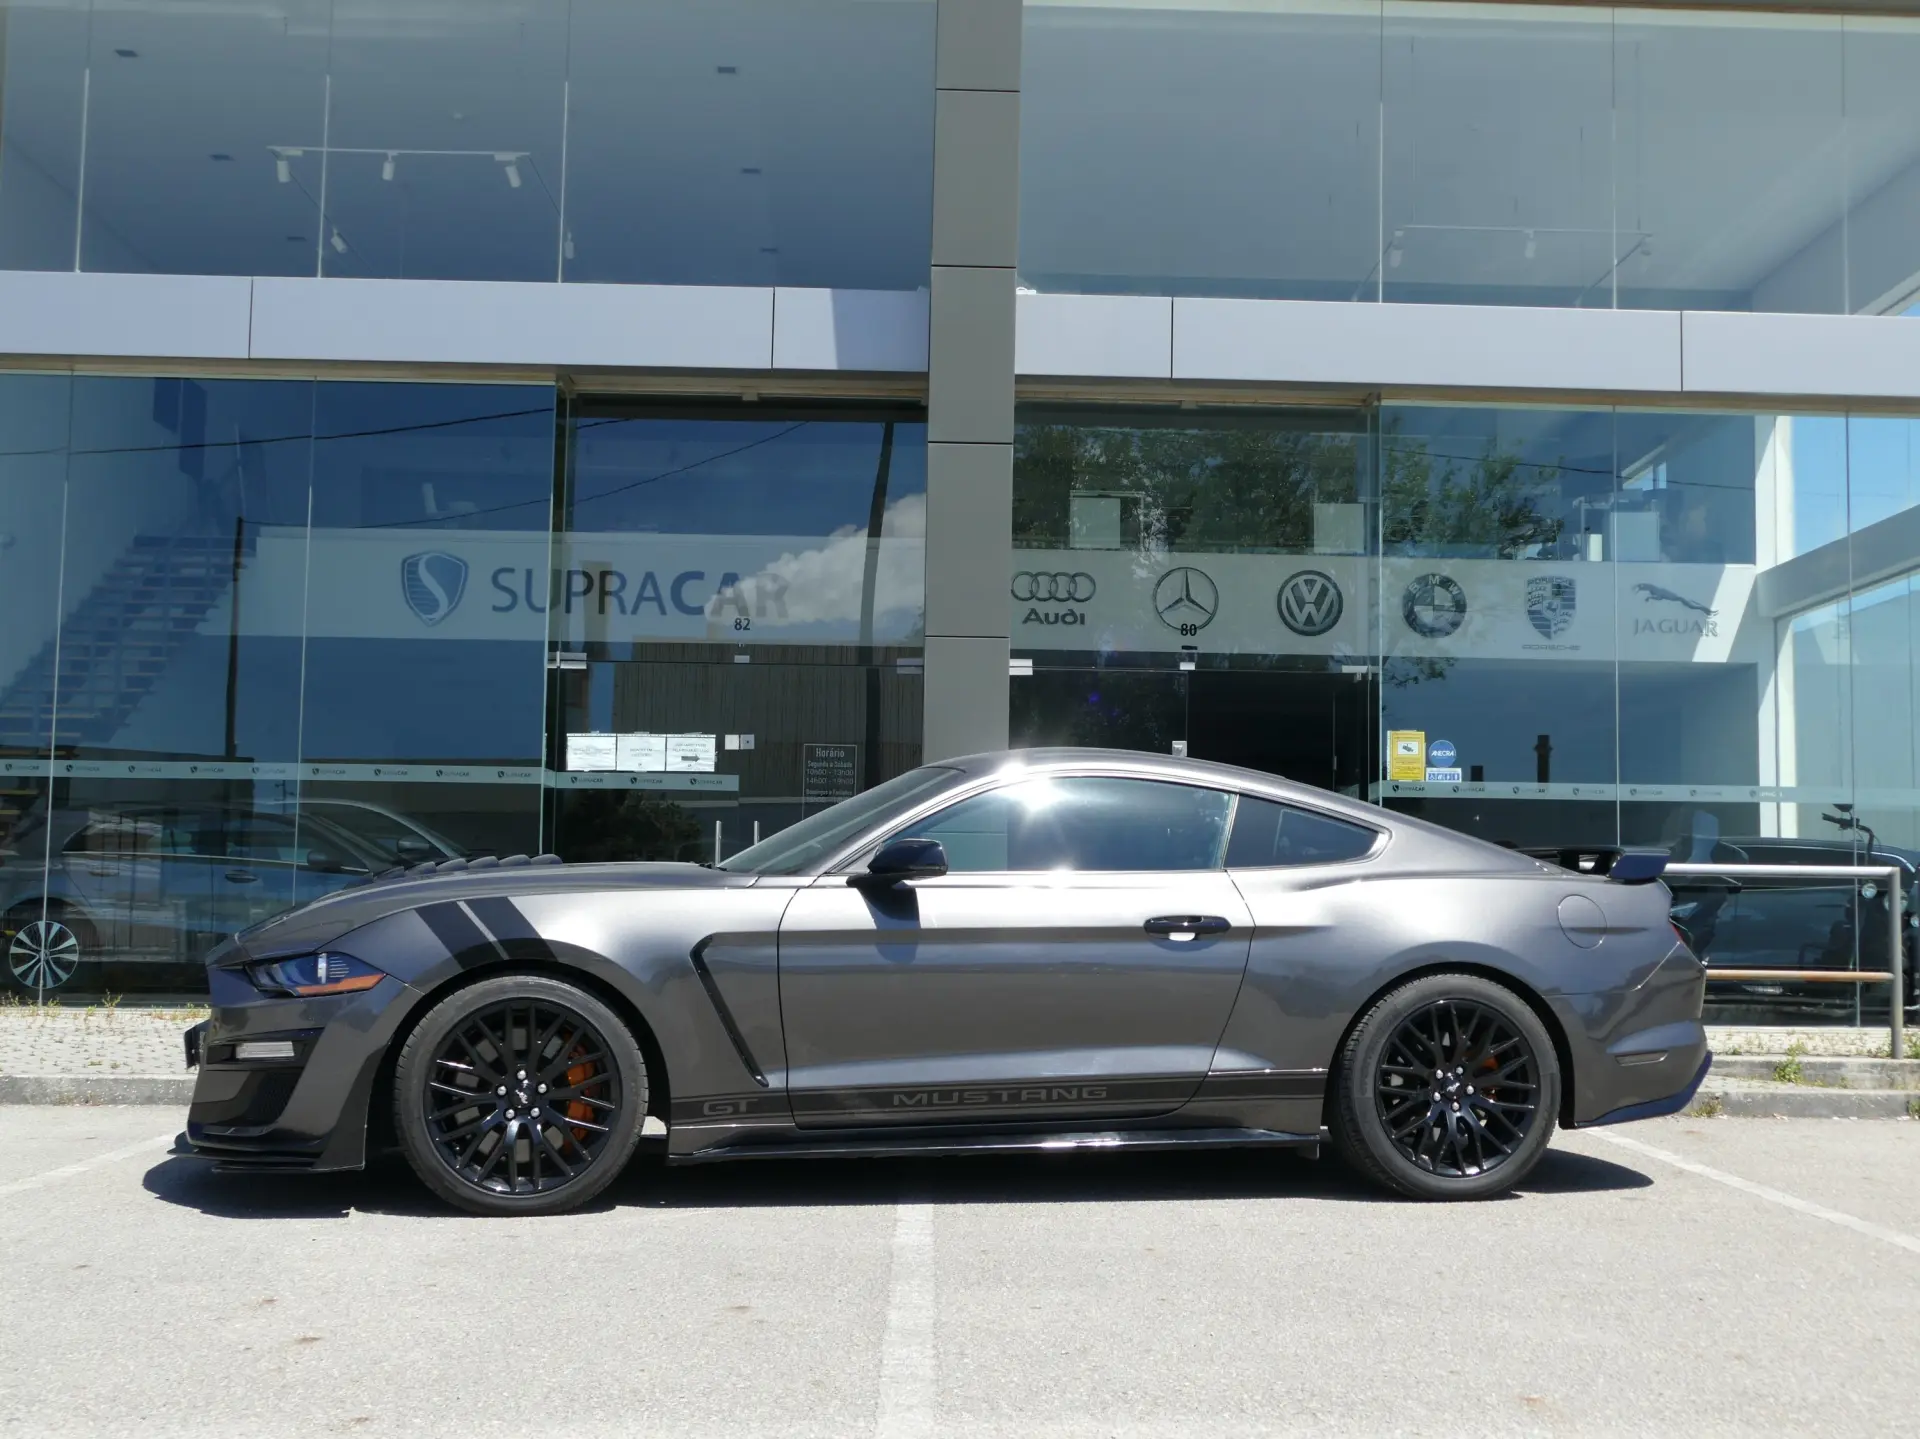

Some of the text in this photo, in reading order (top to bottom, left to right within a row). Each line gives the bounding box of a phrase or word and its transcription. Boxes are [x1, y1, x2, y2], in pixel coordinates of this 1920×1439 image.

[490, 566, 790, 619] SUPRACAR
[734, 618, 750, 631] 82
[1022, 607, 1086, 626] Audi
[1180, 623, 1197, 637] 80
[1633, 618, 1719, 637] JAGUAR
[815, 747, 845, 758] Horário
[893, 1086, 1108, 1107] MUSTANG
[702, 1099, 758, 1116] GT
